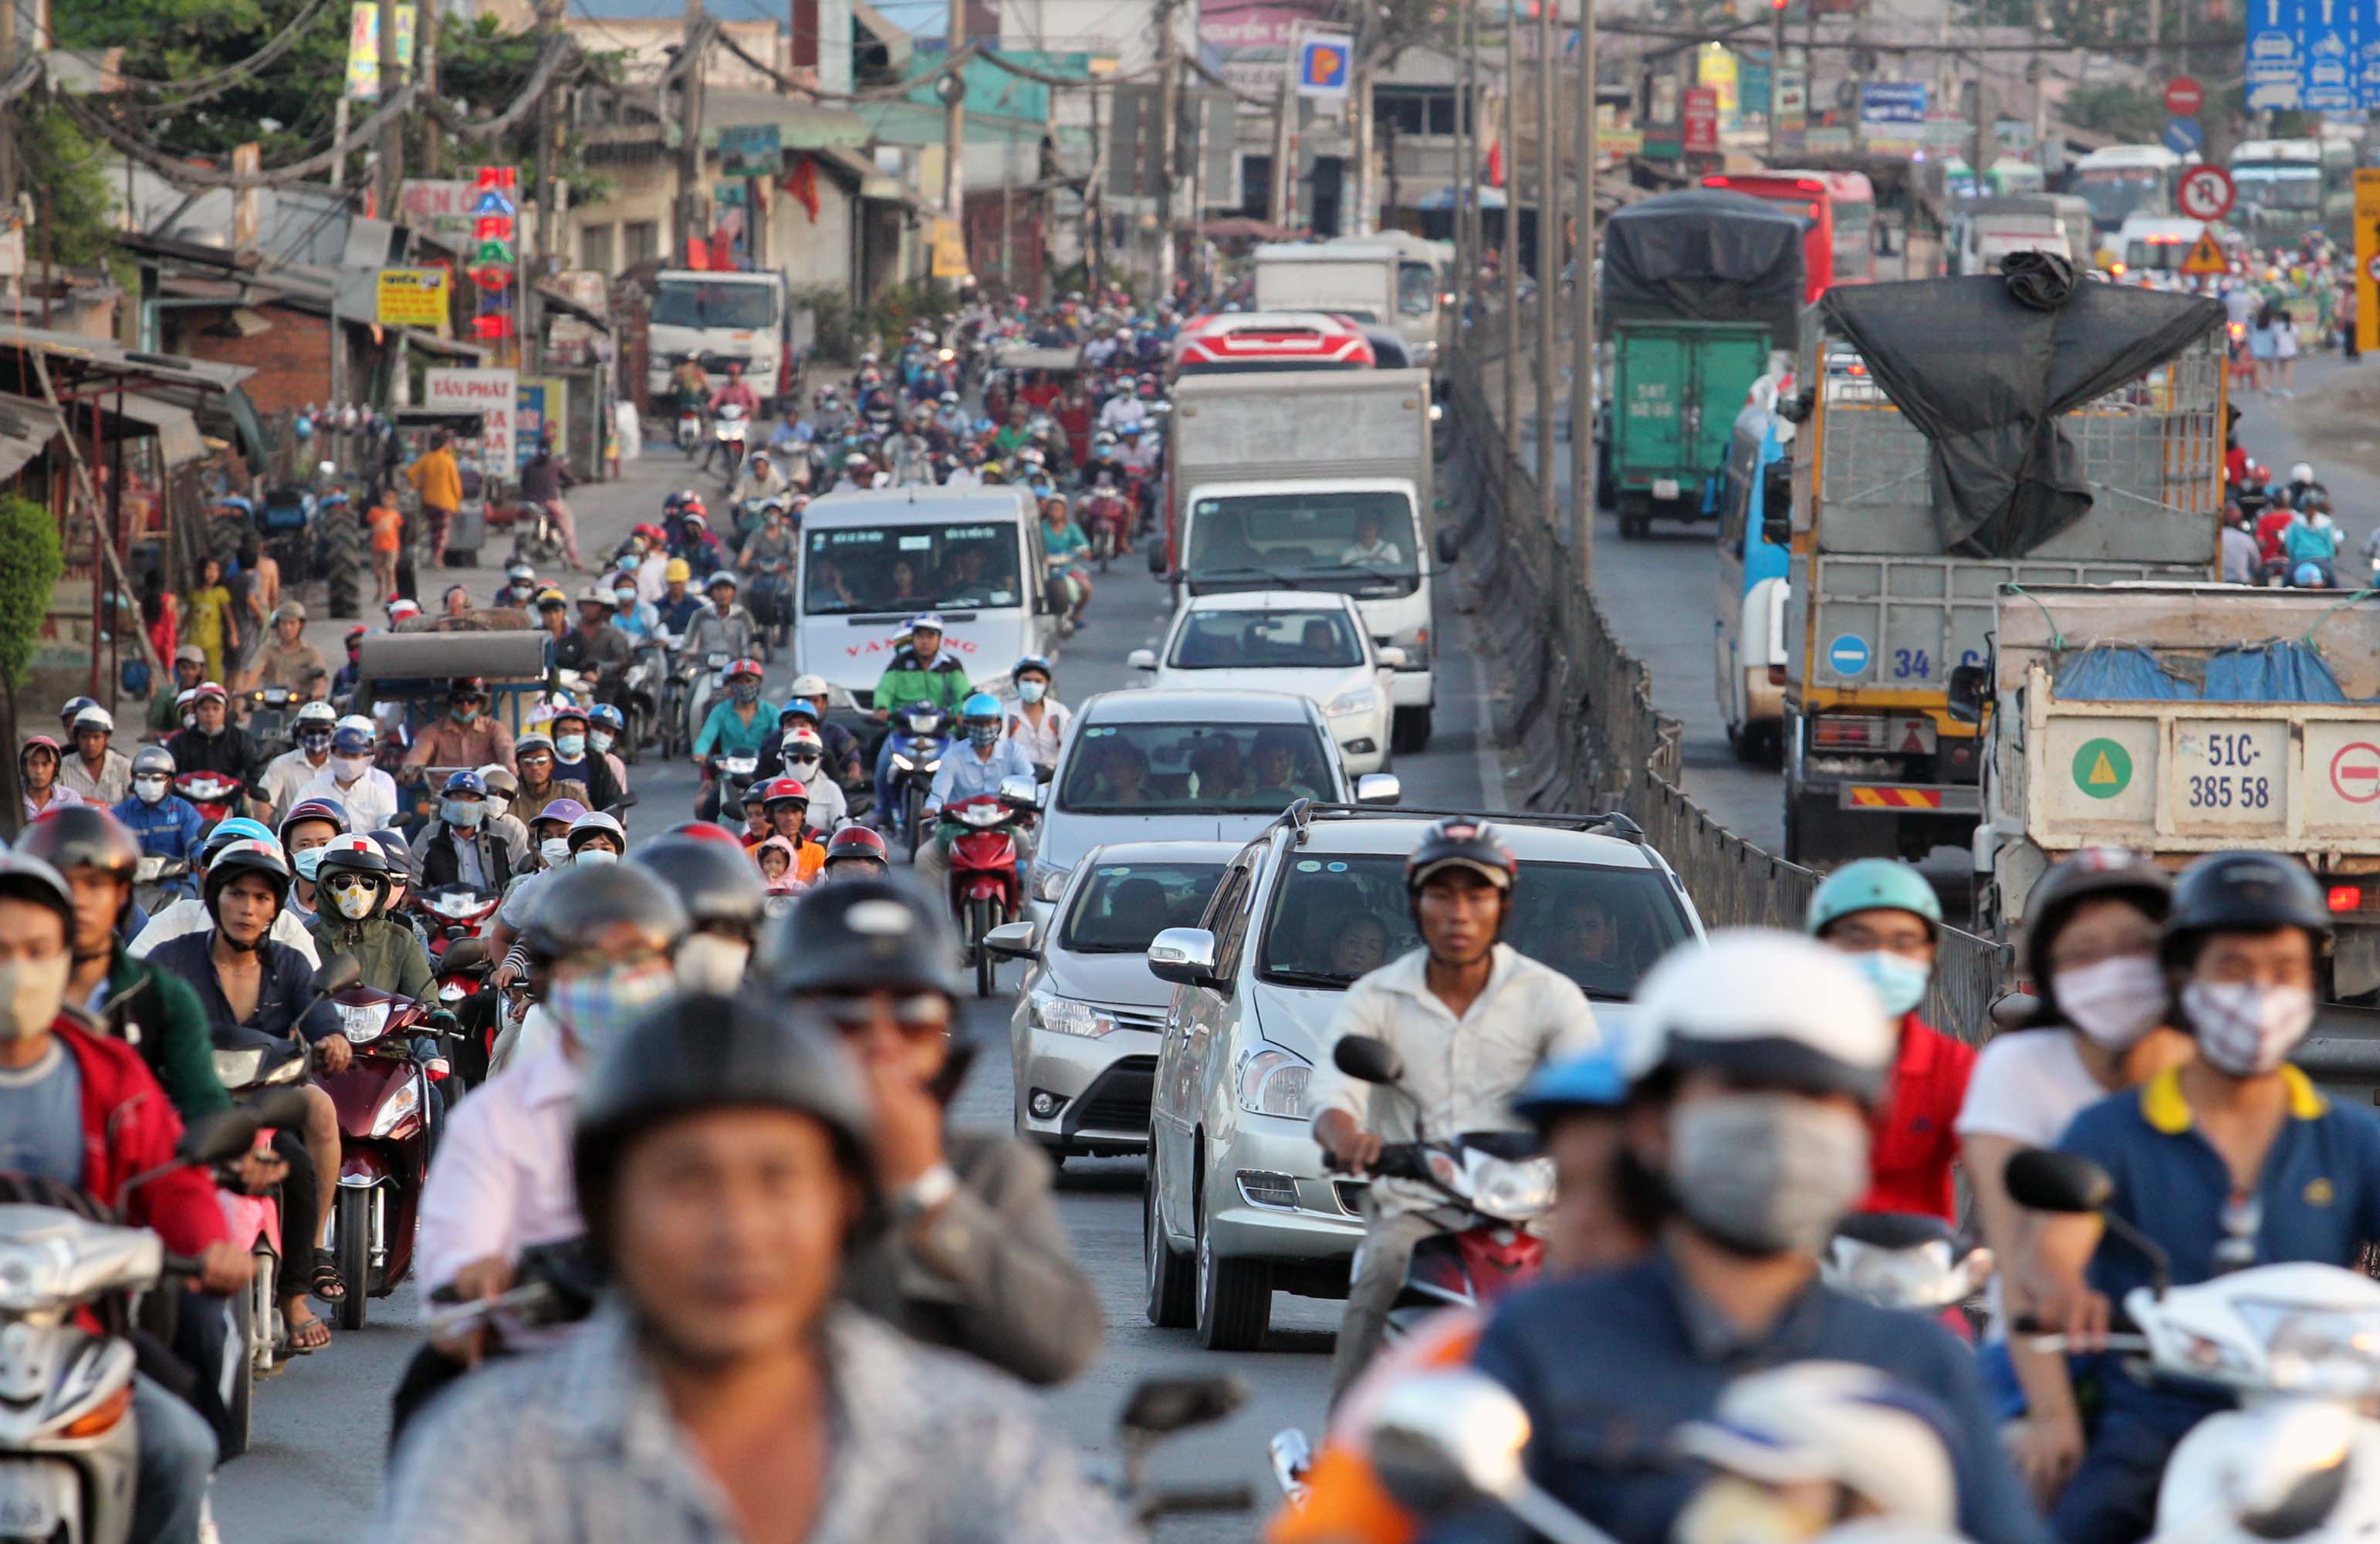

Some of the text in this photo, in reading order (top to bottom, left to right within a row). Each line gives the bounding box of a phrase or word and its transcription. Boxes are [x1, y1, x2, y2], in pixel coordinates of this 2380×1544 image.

[1895, 648, 1930, 678] 34
[2209, 733, 2260, 766] 51C-
[2189, 775, 2270, 809] 385 58
